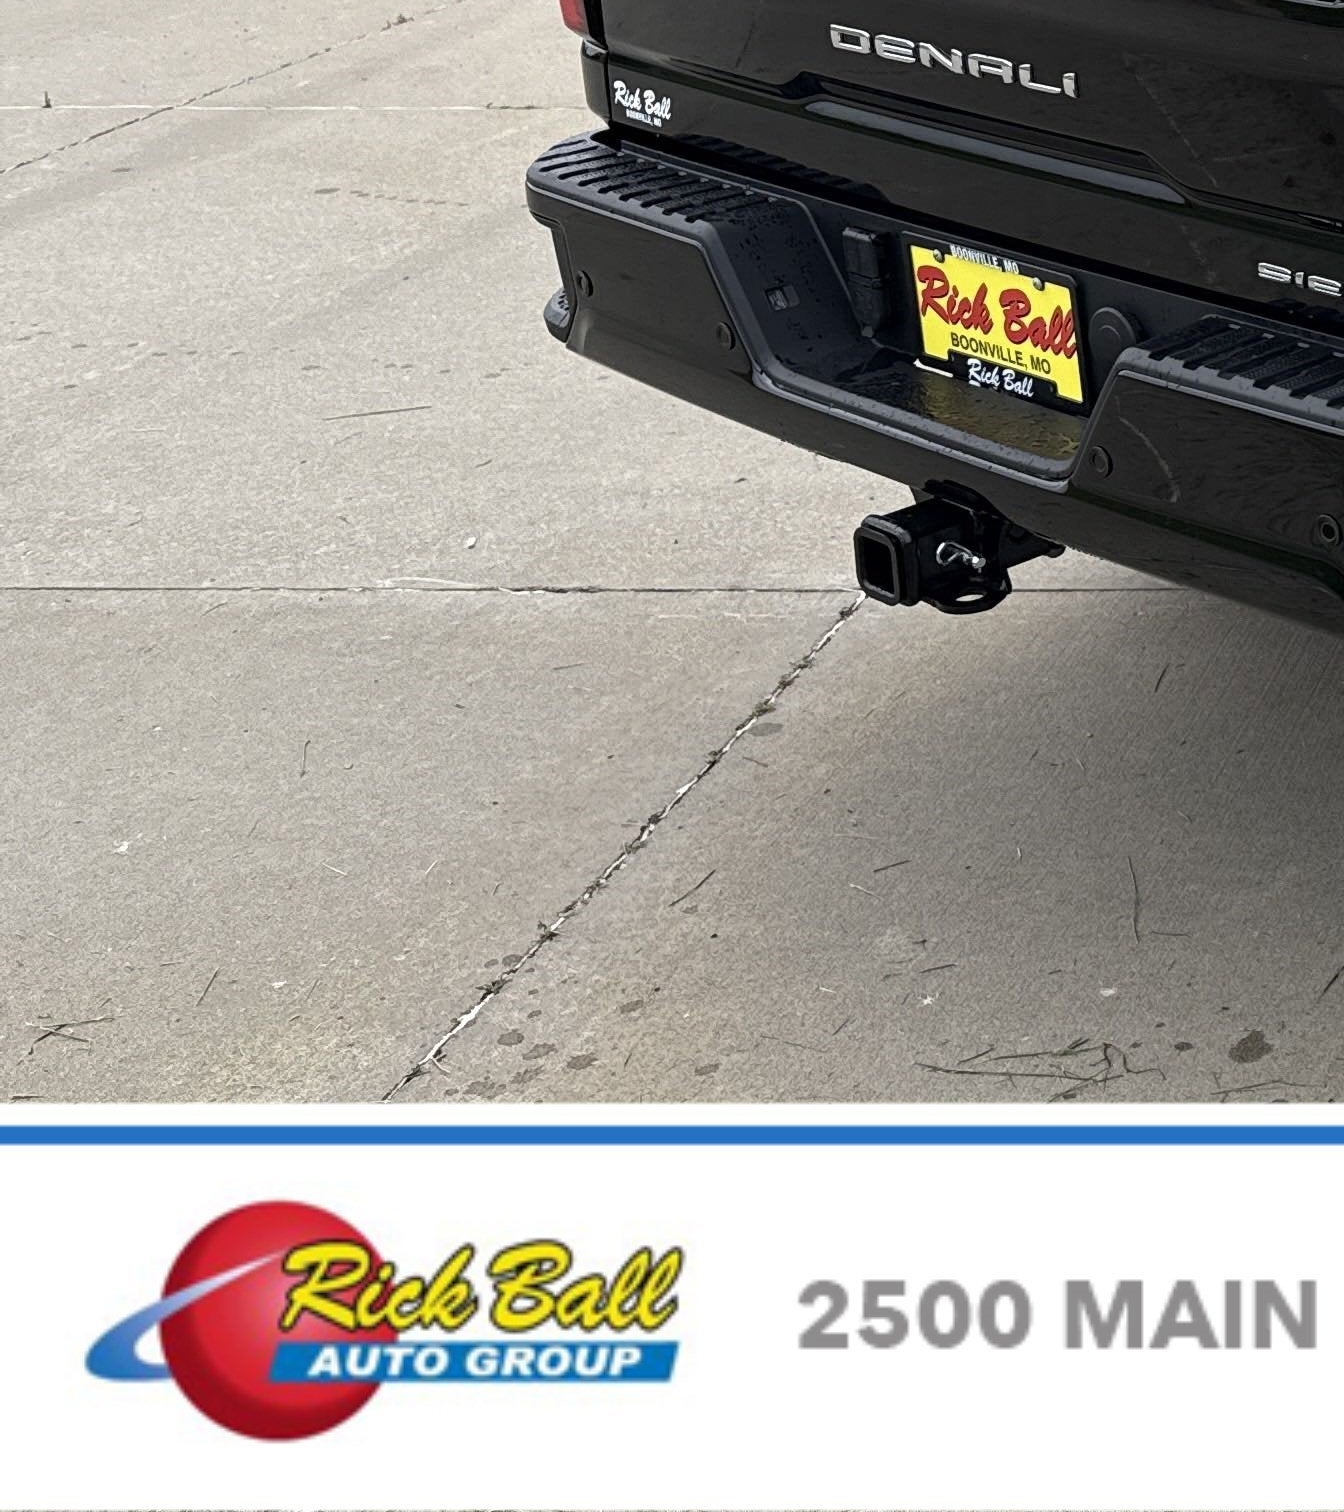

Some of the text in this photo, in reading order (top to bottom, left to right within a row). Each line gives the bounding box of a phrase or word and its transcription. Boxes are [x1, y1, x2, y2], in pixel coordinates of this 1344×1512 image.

[830, 24, 1080, 99] DENALI
[613, 80, 672, 120] Rick Ball
[950, 243, 1020, 275] BOONVILLE, MO
[916, 265, 1077, 360] Rick Ball
[950, 332, 1051, 375] BOONVILLE, MO
[967, 358, 1034, 397] Rick Ball
